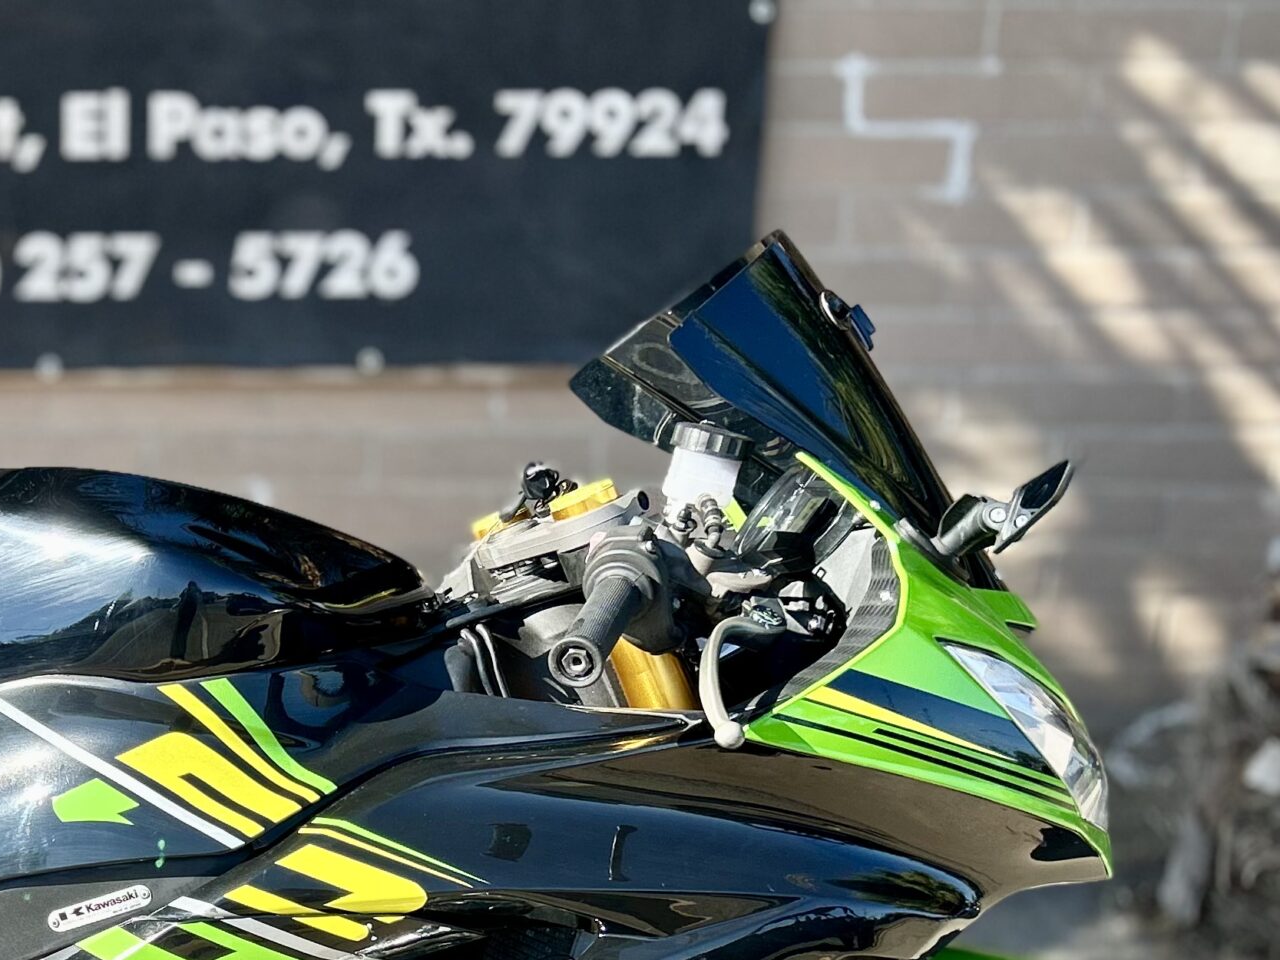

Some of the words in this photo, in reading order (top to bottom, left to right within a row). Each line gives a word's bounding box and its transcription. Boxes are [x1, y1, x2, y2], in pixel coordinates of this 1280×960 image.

[60, 88, 130, 161] El
[147, 90, 350, 170] Paso,
[364, 89, 474, 159] Tx.
[494, 87, 729, 158] 79924
[14, 231, 159, 303] 257
[173, 260, 214, 288] -
[228, 229, 419, 301] 5726
[85, 889, 139, 913] Kawasaki
